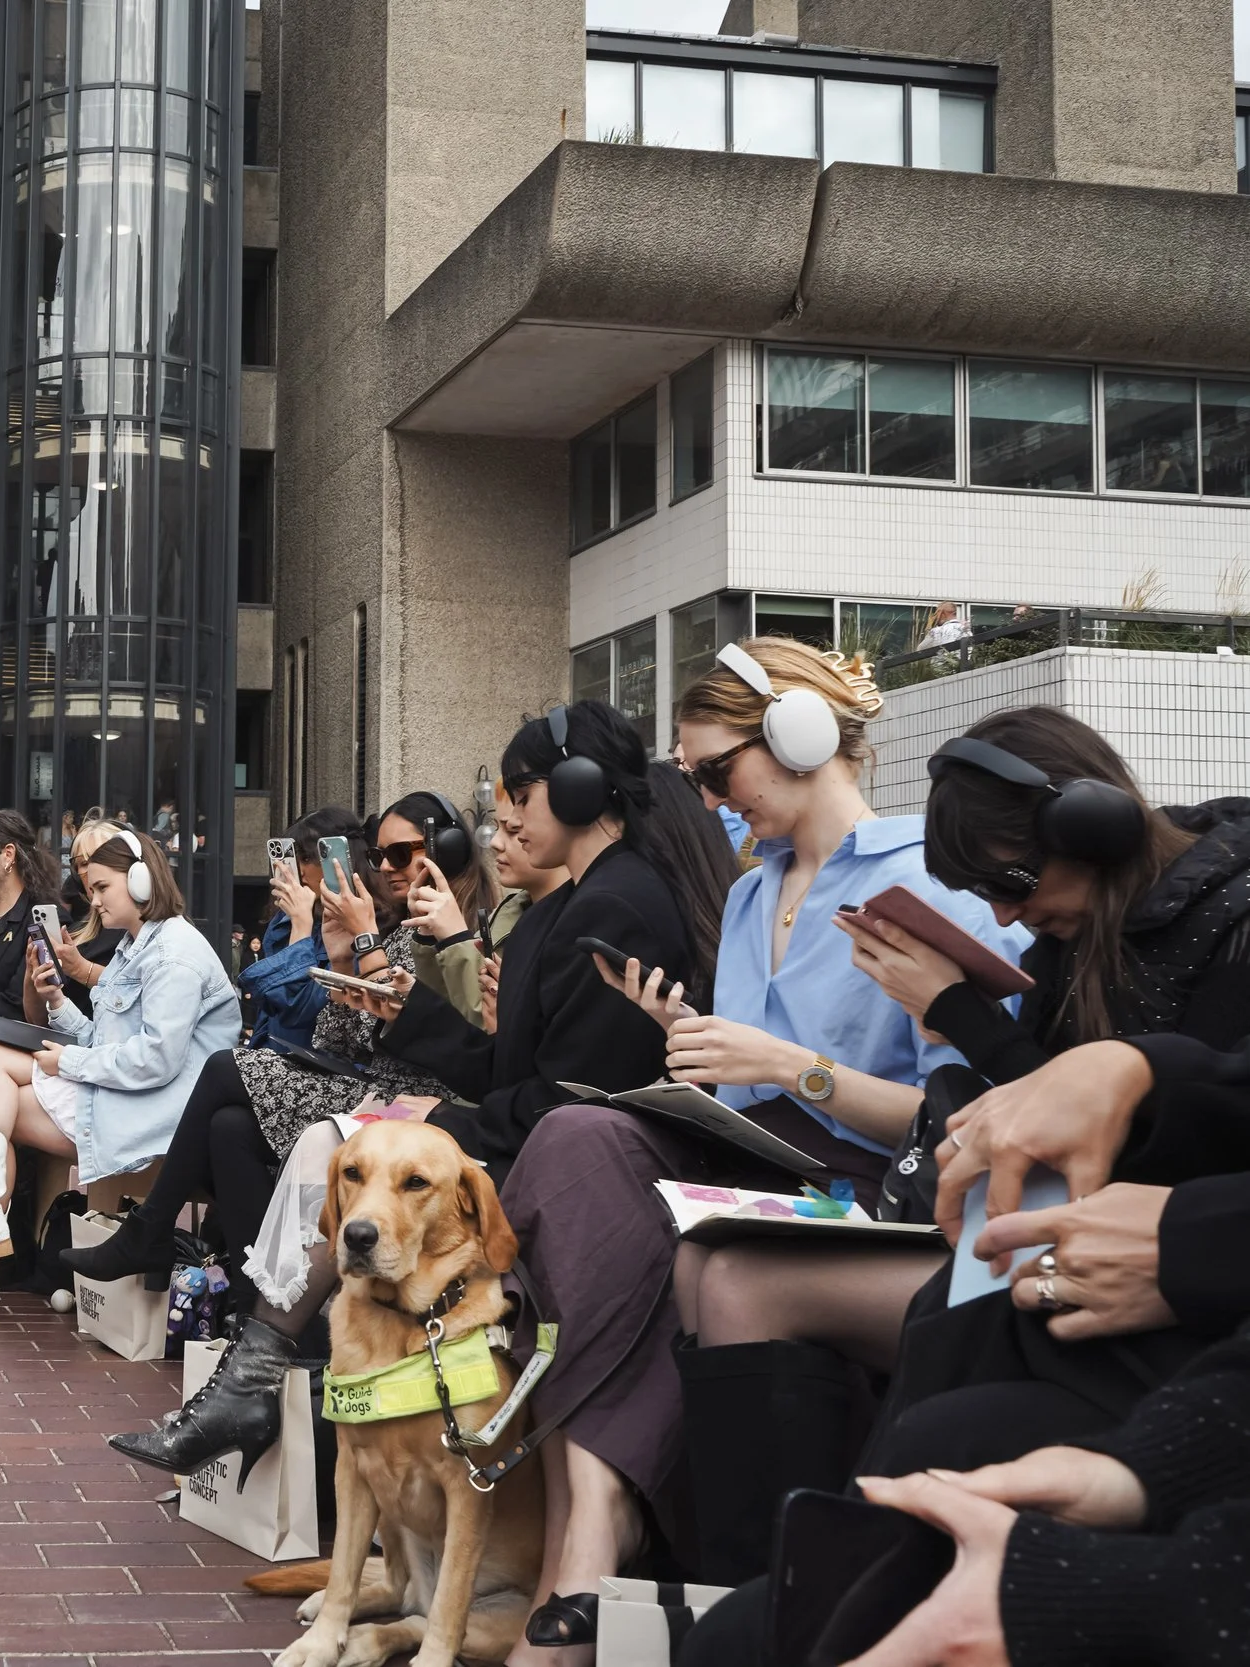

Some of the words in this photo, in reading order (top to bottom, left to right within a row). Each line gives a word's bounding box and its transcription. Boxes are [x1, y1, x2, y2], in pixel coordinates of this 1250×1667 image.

[80, 1285, 105, 1306] AUTHENTIC
[80, 1293, 97, 1312] BEAUTY
[81, 1302, 99, 1322] CONCEPT
[344, 1402, 371, 1416] Dogs
[189, 1478, 218, 1505] CONCEPT
